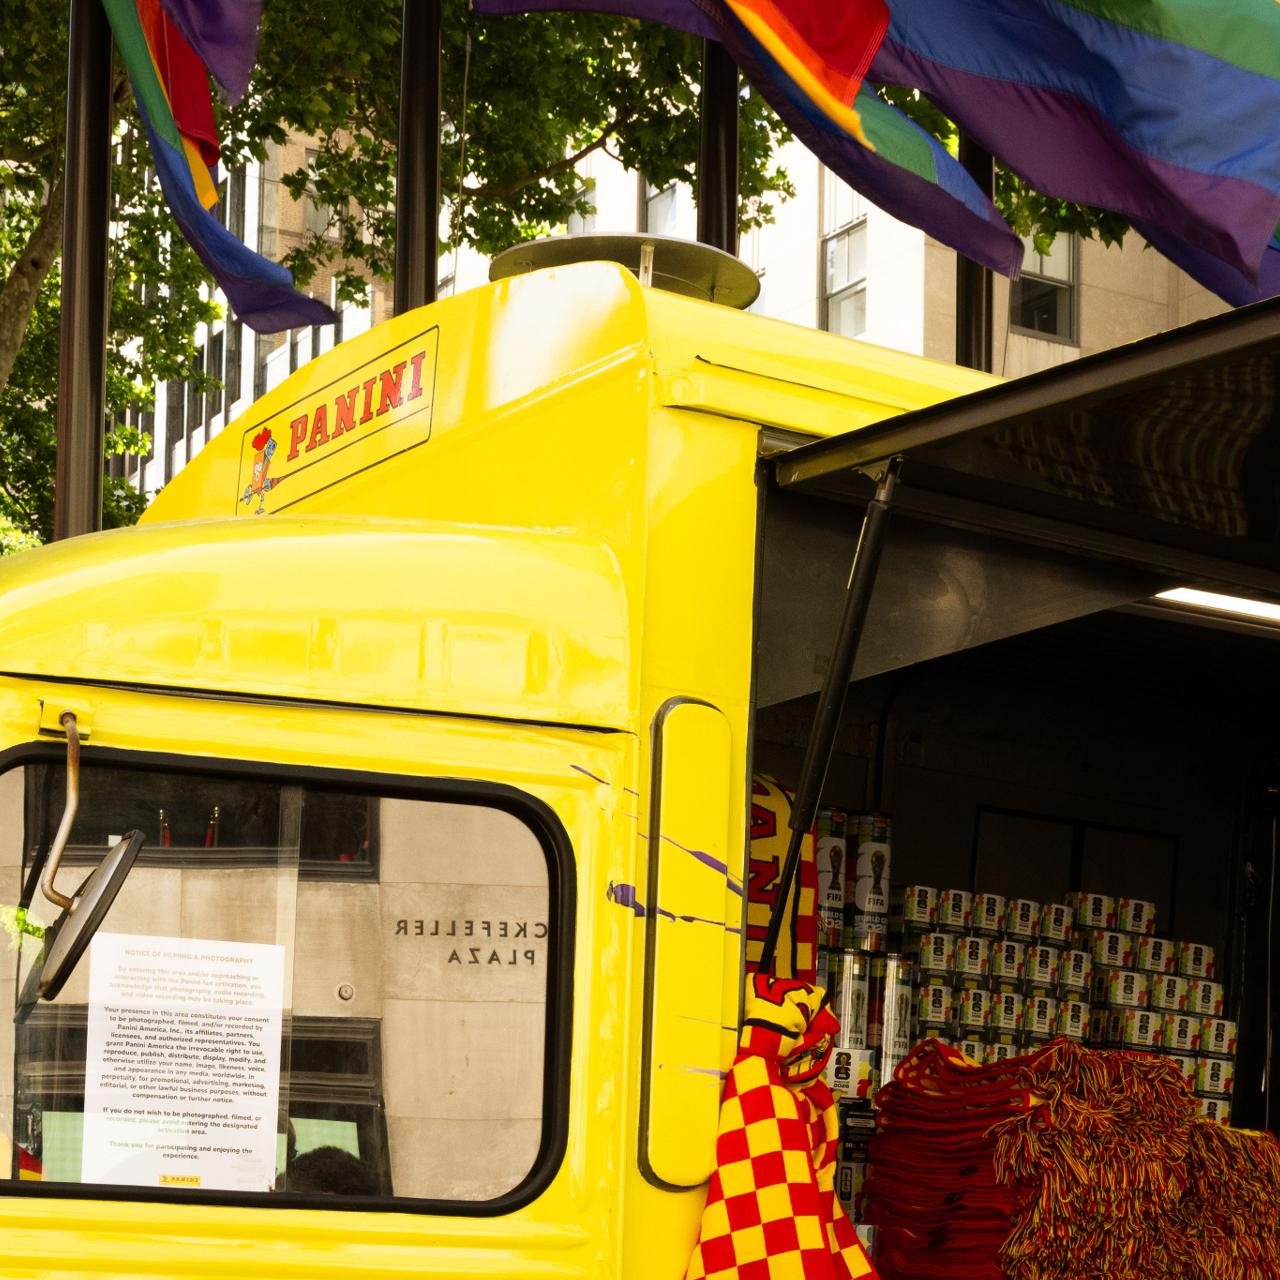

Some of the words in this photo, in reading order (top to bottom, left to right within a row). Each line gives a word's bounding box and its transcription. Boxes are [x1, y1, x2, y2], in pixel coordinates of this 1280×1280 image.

[285, 350, 426, 462] PANINI
[827, 893, 842, 902] FIFA
[868, 898, 884, 907] FIFA
[120, 1008, 151, 1017] presence
[190, 1012, 227, 1020] constitutes
[228, 1015, 243, 1023] your
[244, 1015, 270, 1023] consent
[224, 1022, 254, 1030] recorded
[255, 1024, 263, 1032] by
[158, 1035, 193, 1043] authorized
[849, 1037, 864, 1046] FIFA
[105, 1040, 124, 1048] grant
[147, 1042, 175, 1050] America
[188, 1045, 225, 1053] irrevocable
[226, 1047, 242, 1056] right
[102, 1056, 136, 1064] otherwise
[834, 1052, 852, 1080] 26
[128, 1068, 166, 1076] appearance
[132, 1092, 178, 1102] compensation
[222, 1122, 258, 1131] designated
[155, 1143, 198, 1153] participating
[212, 1146, 241, 1155] enjoying
